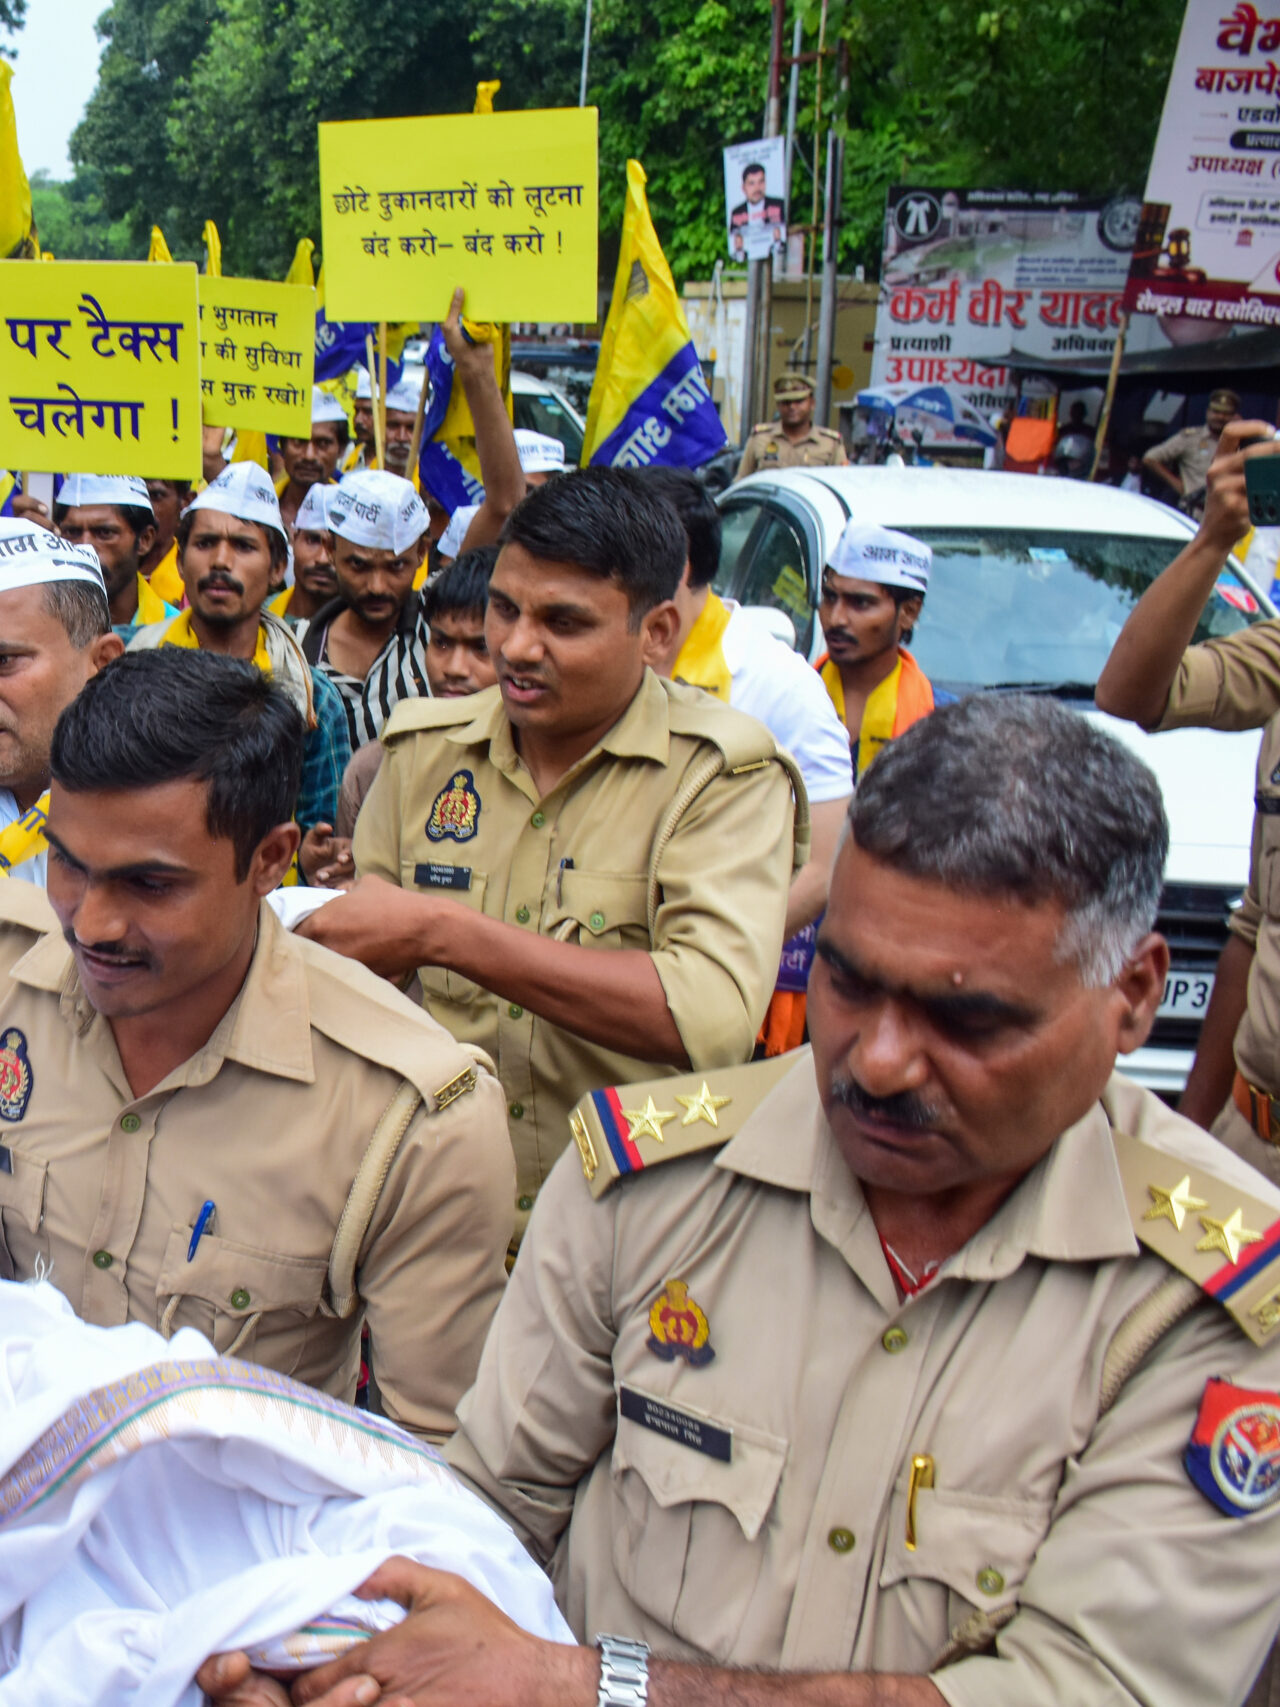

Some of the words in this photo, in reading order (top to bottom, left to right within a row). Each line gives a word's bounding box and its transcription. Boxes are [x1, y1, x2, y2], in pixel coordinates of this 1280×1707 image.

[1237, 104, 1280, 123] एडवो
[1188, 155, 1264, 176] उपाध्यक्ष
[333, 185, 371, 214] छोटे
[378, 181, 478, 221] दुकानदारों
[487, 180, 515, 208] को
[524, 184, 584, 217] लूटना
[361, 230, 391, 257] बंद
[463, 228, 495, 256] बंद
[503, 225, 545, 254] करो
[888, 278, 962, 327] कर्म
[969, 278, 1027, 328] वीर
[1214, 296, 1280, 325] एसोसिए
[6, 317, 72, 360] पर
[78, 293, 184, 363] टैक्स
[213, 305, 279, 331] भुगतान
[215, 336, 238, 361] की
[244, 341, 303, 372] सुविधा
[889, 334, 951, 353] प्रत्याशी
[222, 381, 257, 407] मुक्त
[263, 382, 306, 407] रखो!
[8, 383, 145, 441] चलेगा
[355, 501, 382, 525] पार्टी
[862, 544, 899, 563] आम
